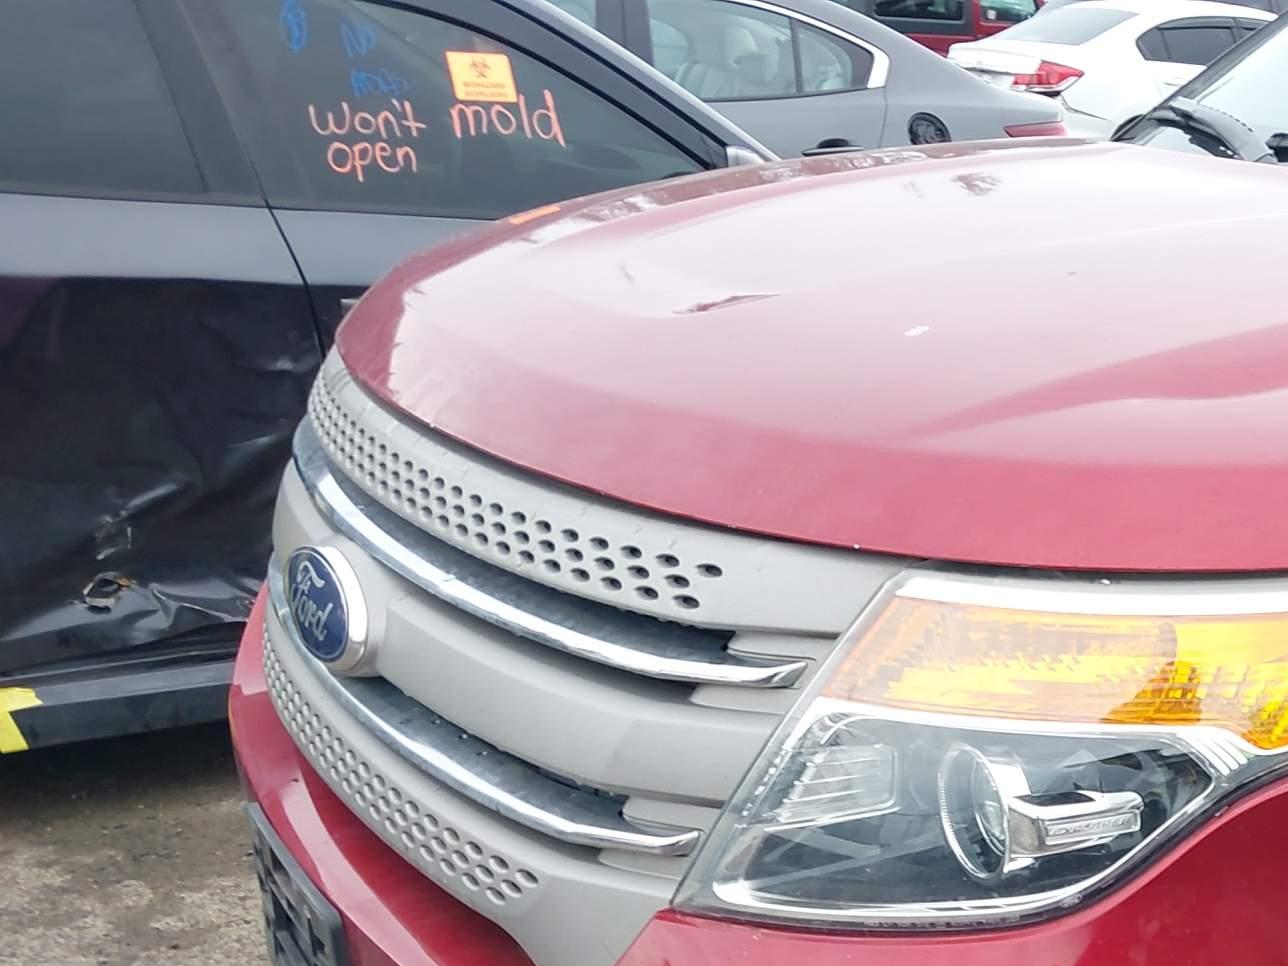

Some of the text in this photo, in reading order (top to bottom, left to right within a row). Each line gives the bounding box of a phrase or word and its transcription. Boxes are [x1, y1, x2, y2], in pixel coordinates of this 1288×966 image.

[450, 89, 566, 148] mold
[327, 142, 418, 182] open
[291, 560, 334, 641] Ford
